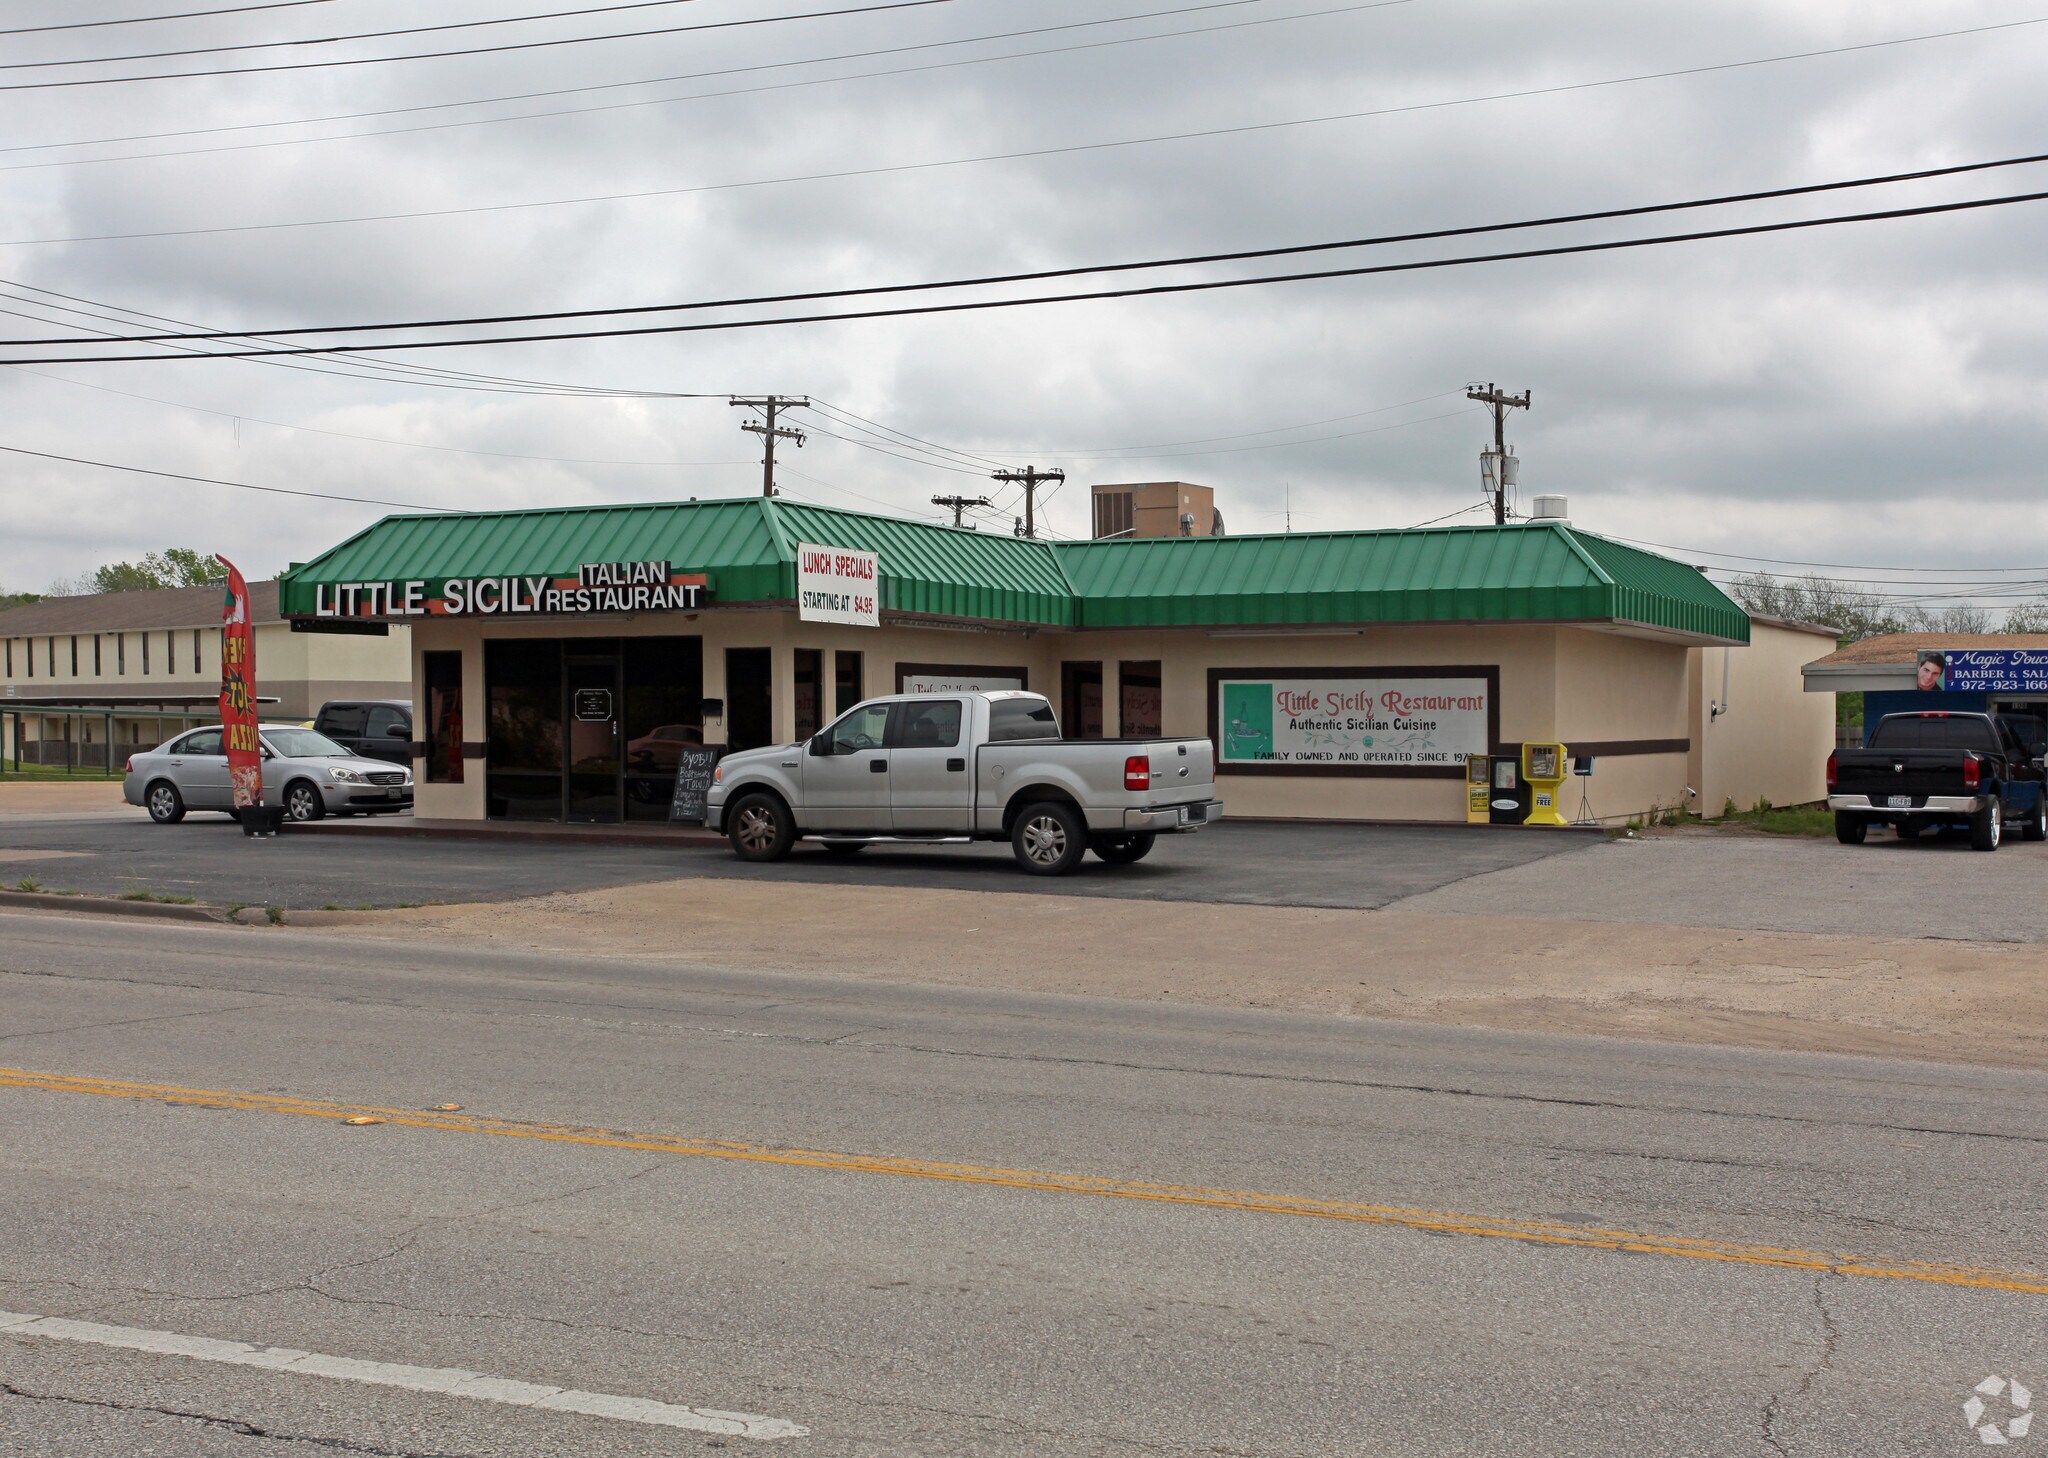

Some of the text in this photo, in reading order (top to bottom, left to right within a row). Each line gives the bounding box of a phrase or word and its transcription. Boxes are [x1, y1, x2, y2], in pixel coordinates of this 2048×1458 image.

[578, 561, 667, 586] ITALIAN
[803, 552, 873, 580] LUNCH SPECIALS
[316, 577, 548, 617] LITTLE SICILY
[546, 585, 701, 612] RESTAURANT
[803, 591, 873, 614] STARTING AT $4.95
[1955, 651, 2006, 669] Magic
[1955, 670, 2004, 678] BARBER
[2009, 670, 2018, 678] &
[1277, 690, 1484, 720] Little Sicily Restaurant
[1289, 718, 1437, 730] Authentic Sicilian Cuisine
[1254, 752, 1474, 763] FAMILY OWNED AND OPERATED SINCE 197
